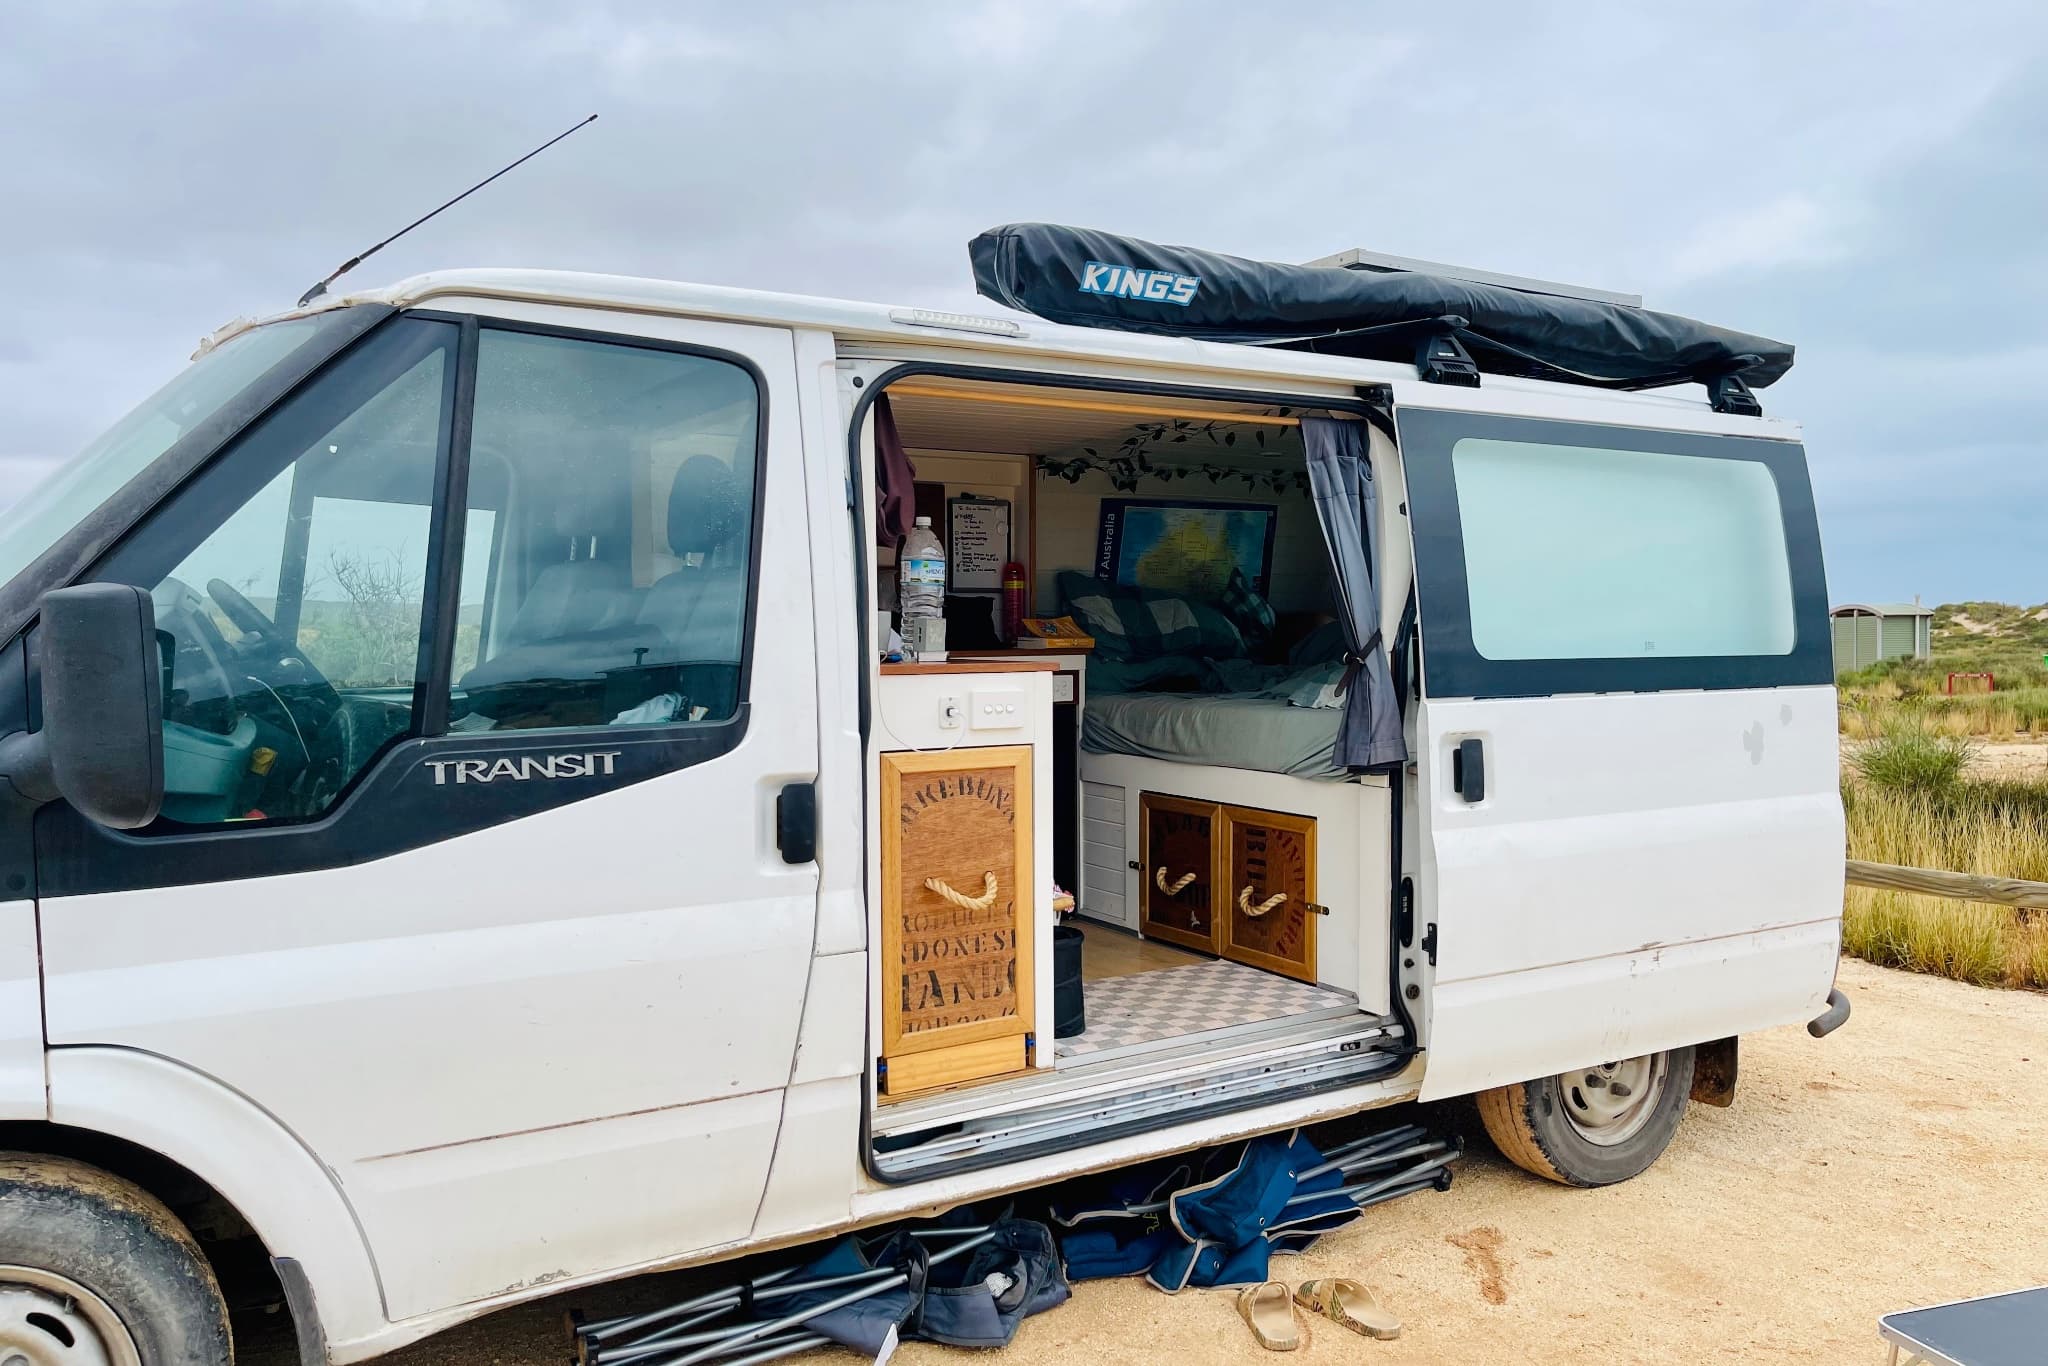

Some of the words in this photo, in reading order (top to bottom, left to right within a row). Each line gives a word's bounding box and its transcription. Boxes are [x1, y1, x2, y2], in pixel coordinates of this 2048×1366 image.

[1082, 264, 1197, 303] KINGS
[1101, 513, 1115, 570] Australia
[424, 752, 622, 785] TRANSIT
